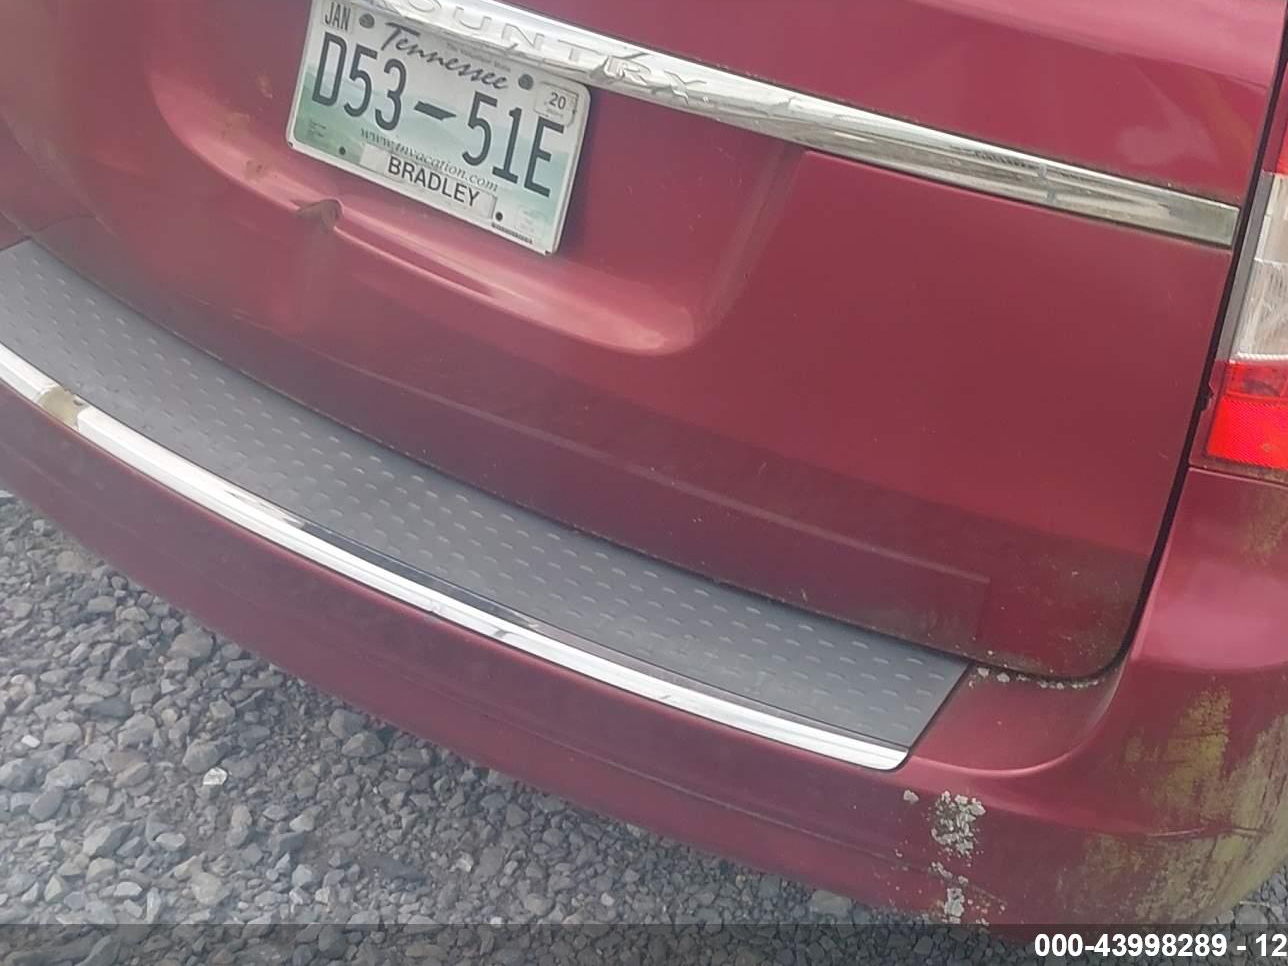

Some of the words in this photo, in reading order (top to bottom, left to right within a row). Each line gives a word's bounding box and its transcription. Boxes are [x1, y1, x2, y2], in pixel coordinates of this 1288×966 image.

[324, 0, 350, 32] JAN
[380, 21, 509, 90] Tennessee
[549, 91, 567, 111] 20
[387, 154, 481, 207] BRADLEY
